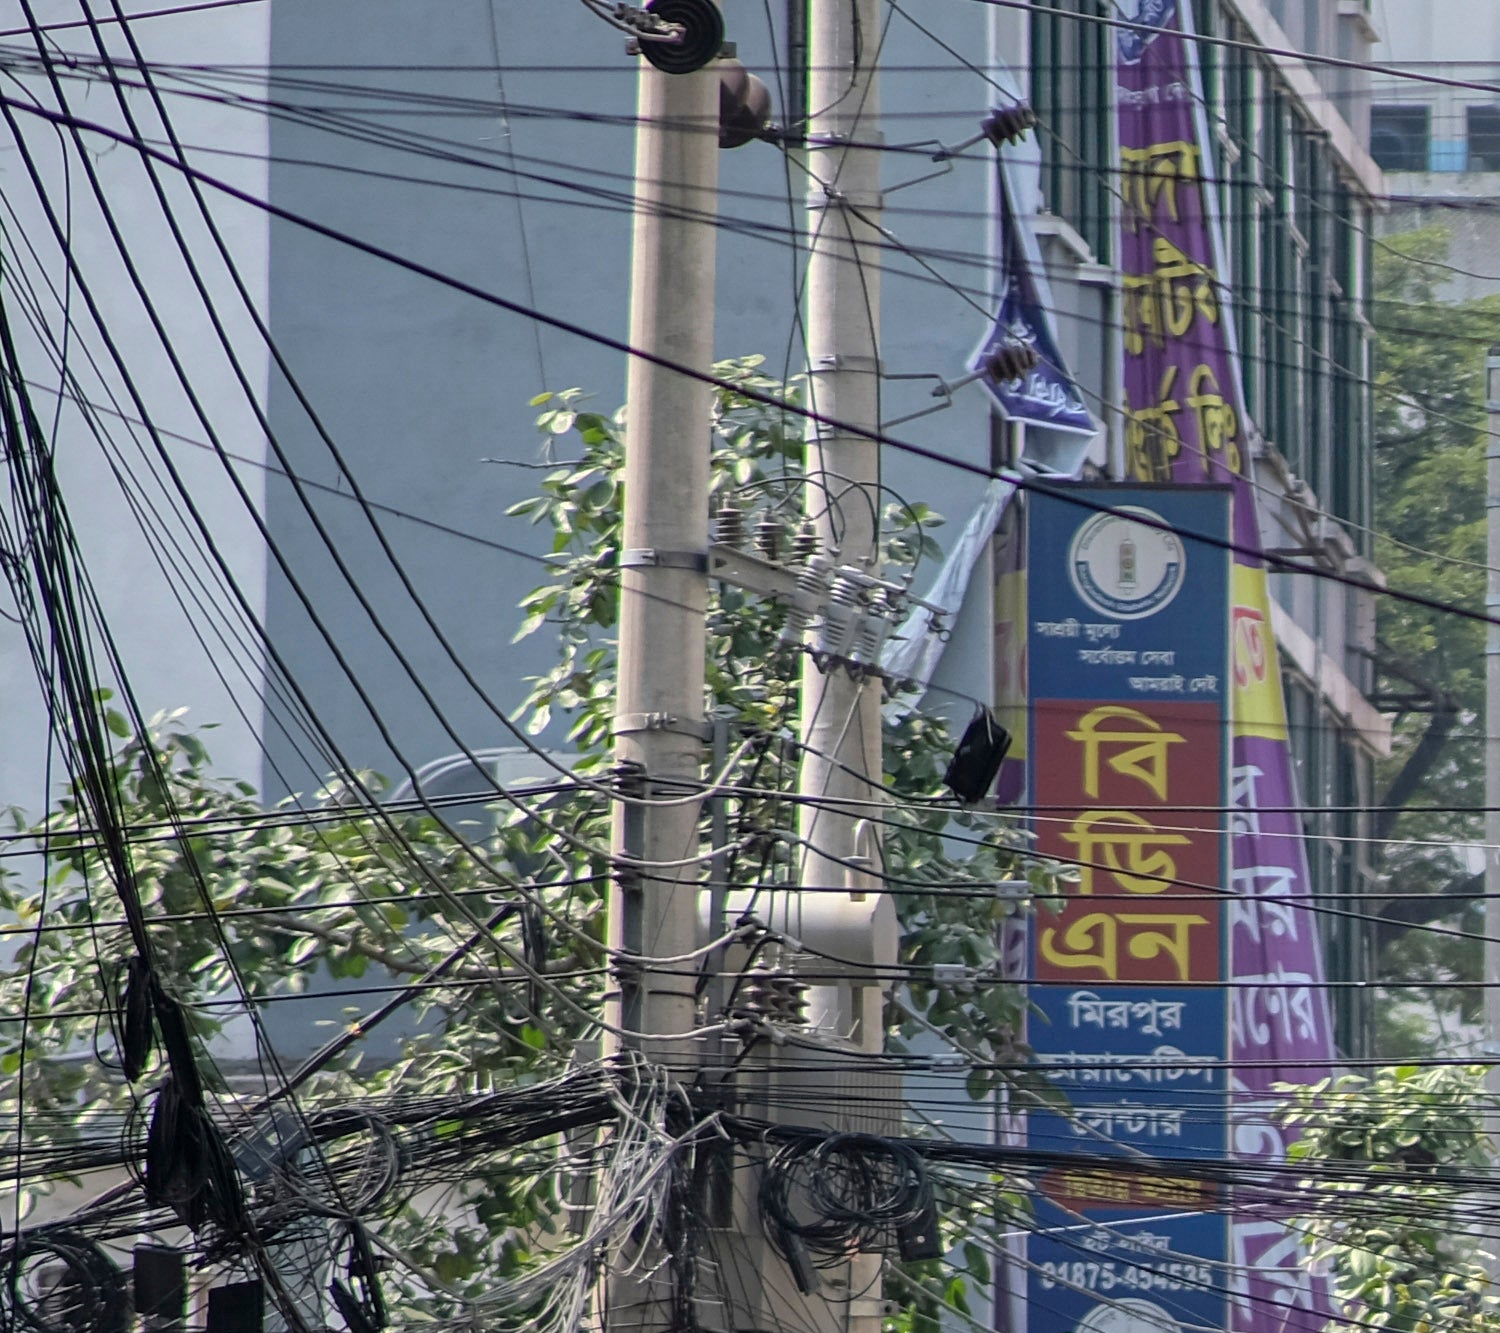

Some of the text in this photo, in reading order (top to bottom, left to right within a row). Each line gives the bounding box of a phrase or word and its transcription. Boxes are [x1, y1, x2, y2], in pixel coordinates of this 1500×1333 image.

[1129, 675, 1185, 693] আমরাই
[1141, 650, 1175, 665] সেবা
[1066, 704, 1187, 802] বি
[1060, 810, 1192, 896] ডি
[1040, 912, 1210, 982] এন
[1067, 990, 1187, 1037] মিরপুর
